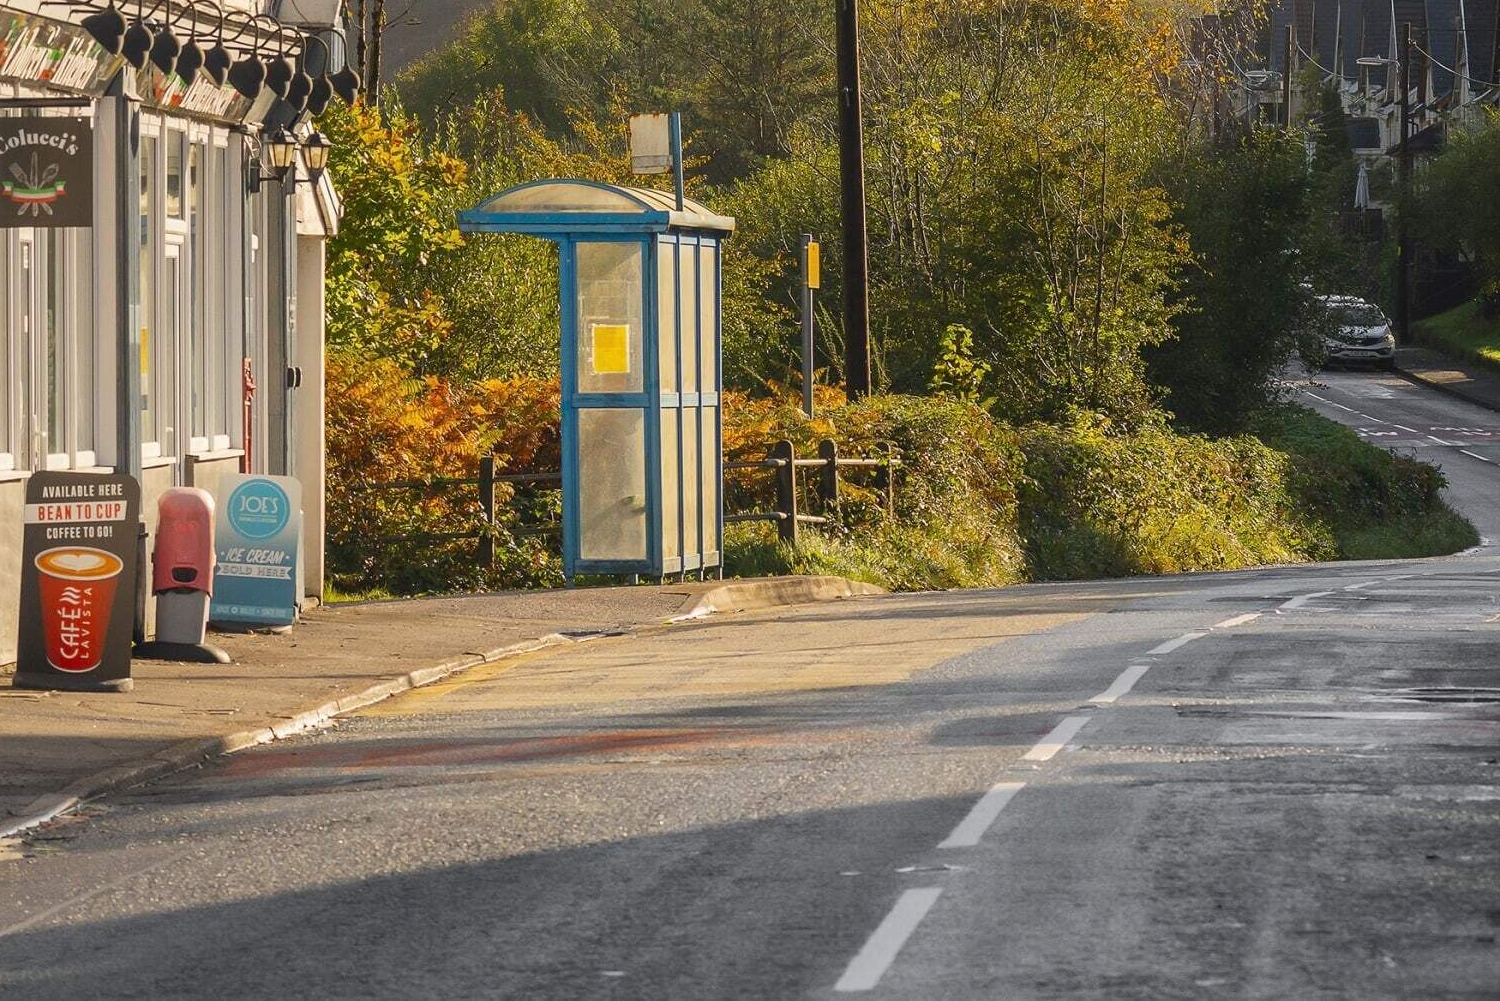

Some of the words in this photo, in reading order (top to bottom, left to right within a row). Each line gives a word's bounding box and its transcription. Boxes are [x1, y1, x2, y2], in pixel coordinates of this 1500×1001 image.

[42, 485, 95, 499] AVAILABLE
[98, 483, 124, 496] HERE
[38, 505, 72, 521] BEAN
[76, 504, 92, 520] TO
[96, 502, 121, 519] CUP
[239, 496, 278, 514] JOE'S
[46, 526, 81, 540] COFFEE
[83, 526, 95, 538] TO
[97, 525, 113, 537] GO!
[225, 548, 245, 562] ICE
[246, 549, 285, 565] CREAM
[221, 564, 253, 576] SOLD
[257, 567, 286, 578] HERE
[57, 607, 81, 659] CAFÉ
